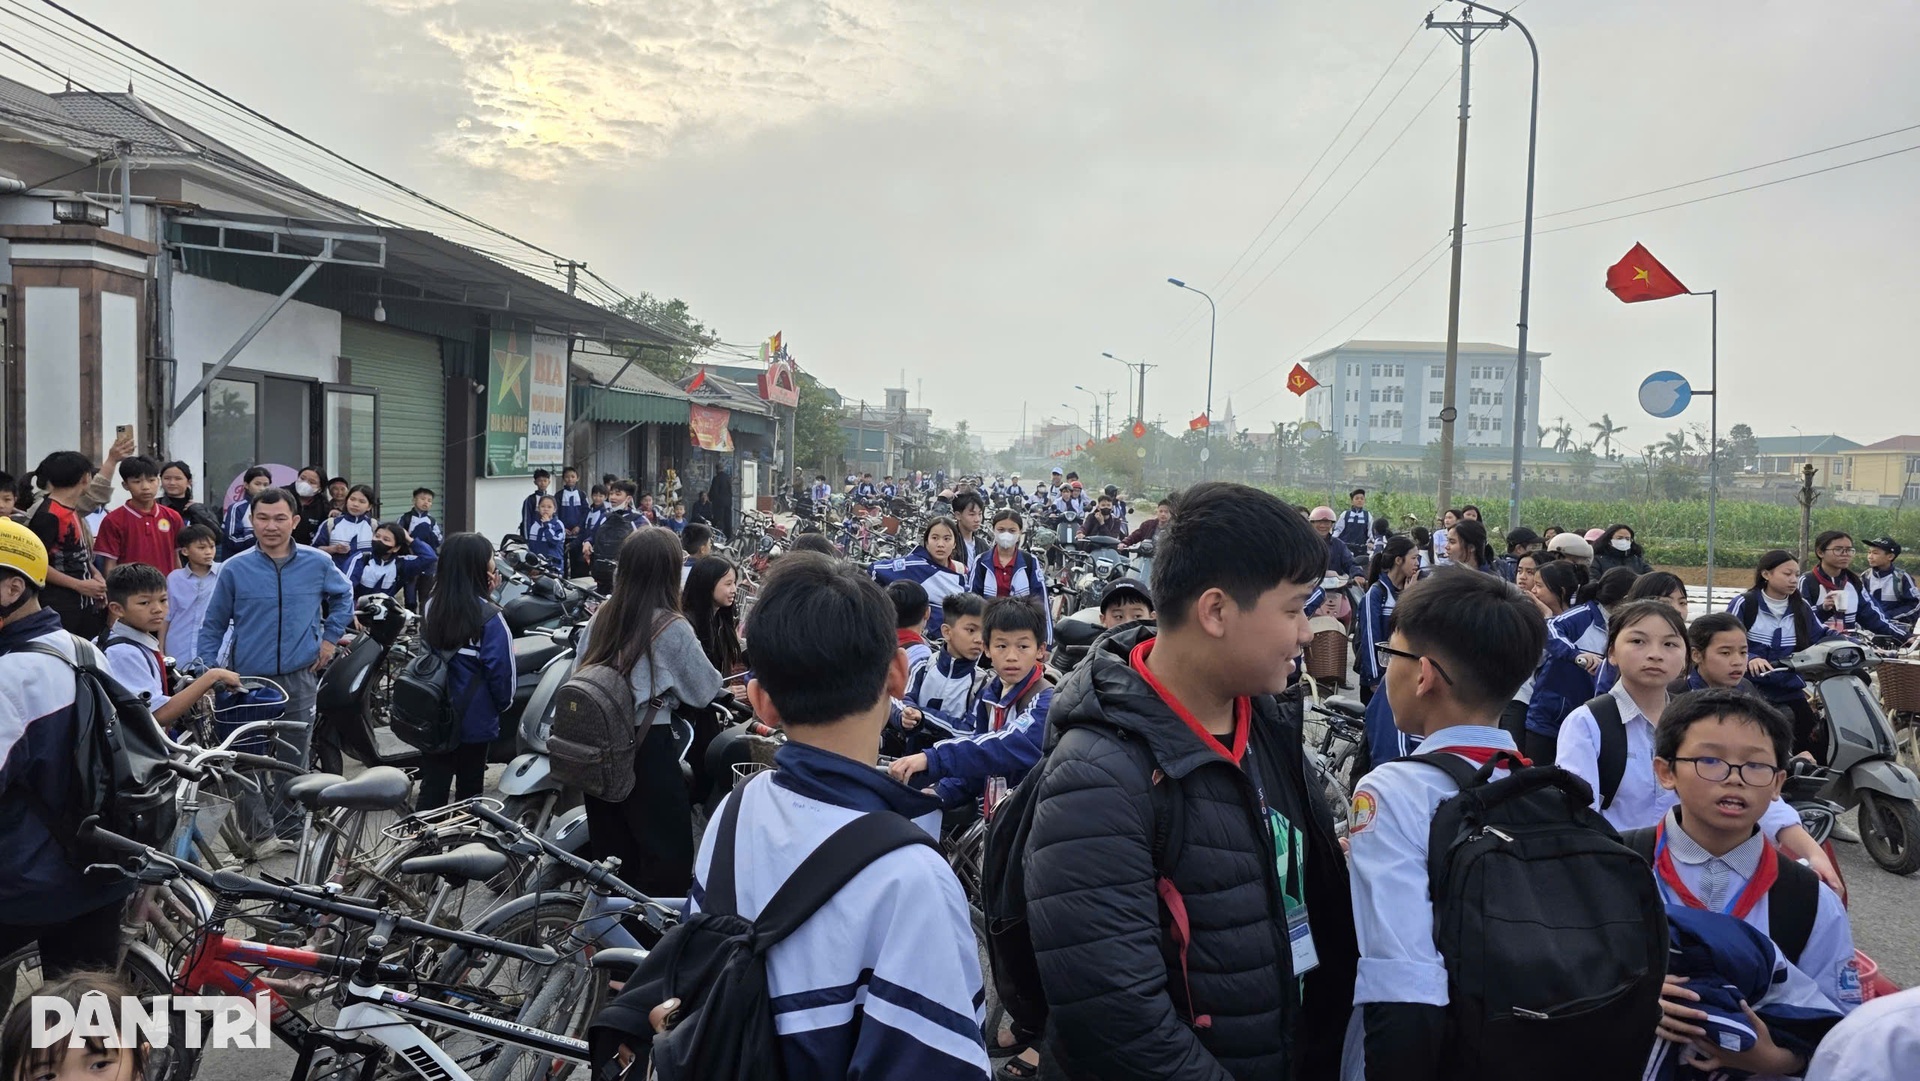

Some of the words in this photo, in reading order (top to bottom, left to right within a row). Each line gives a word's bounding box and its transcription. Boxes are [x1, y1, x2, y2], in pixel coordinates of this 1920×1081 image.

[534, 352, 564, 387] BIA
[490, 413, 501, 432] BIA
[502, 414, 513, 432] SAO
[468, 1011, 530, 1036] ALUMINIUM
[529, 1027, 553, 1040] LITE
[552, 1033, 588, 1049] SUPER
